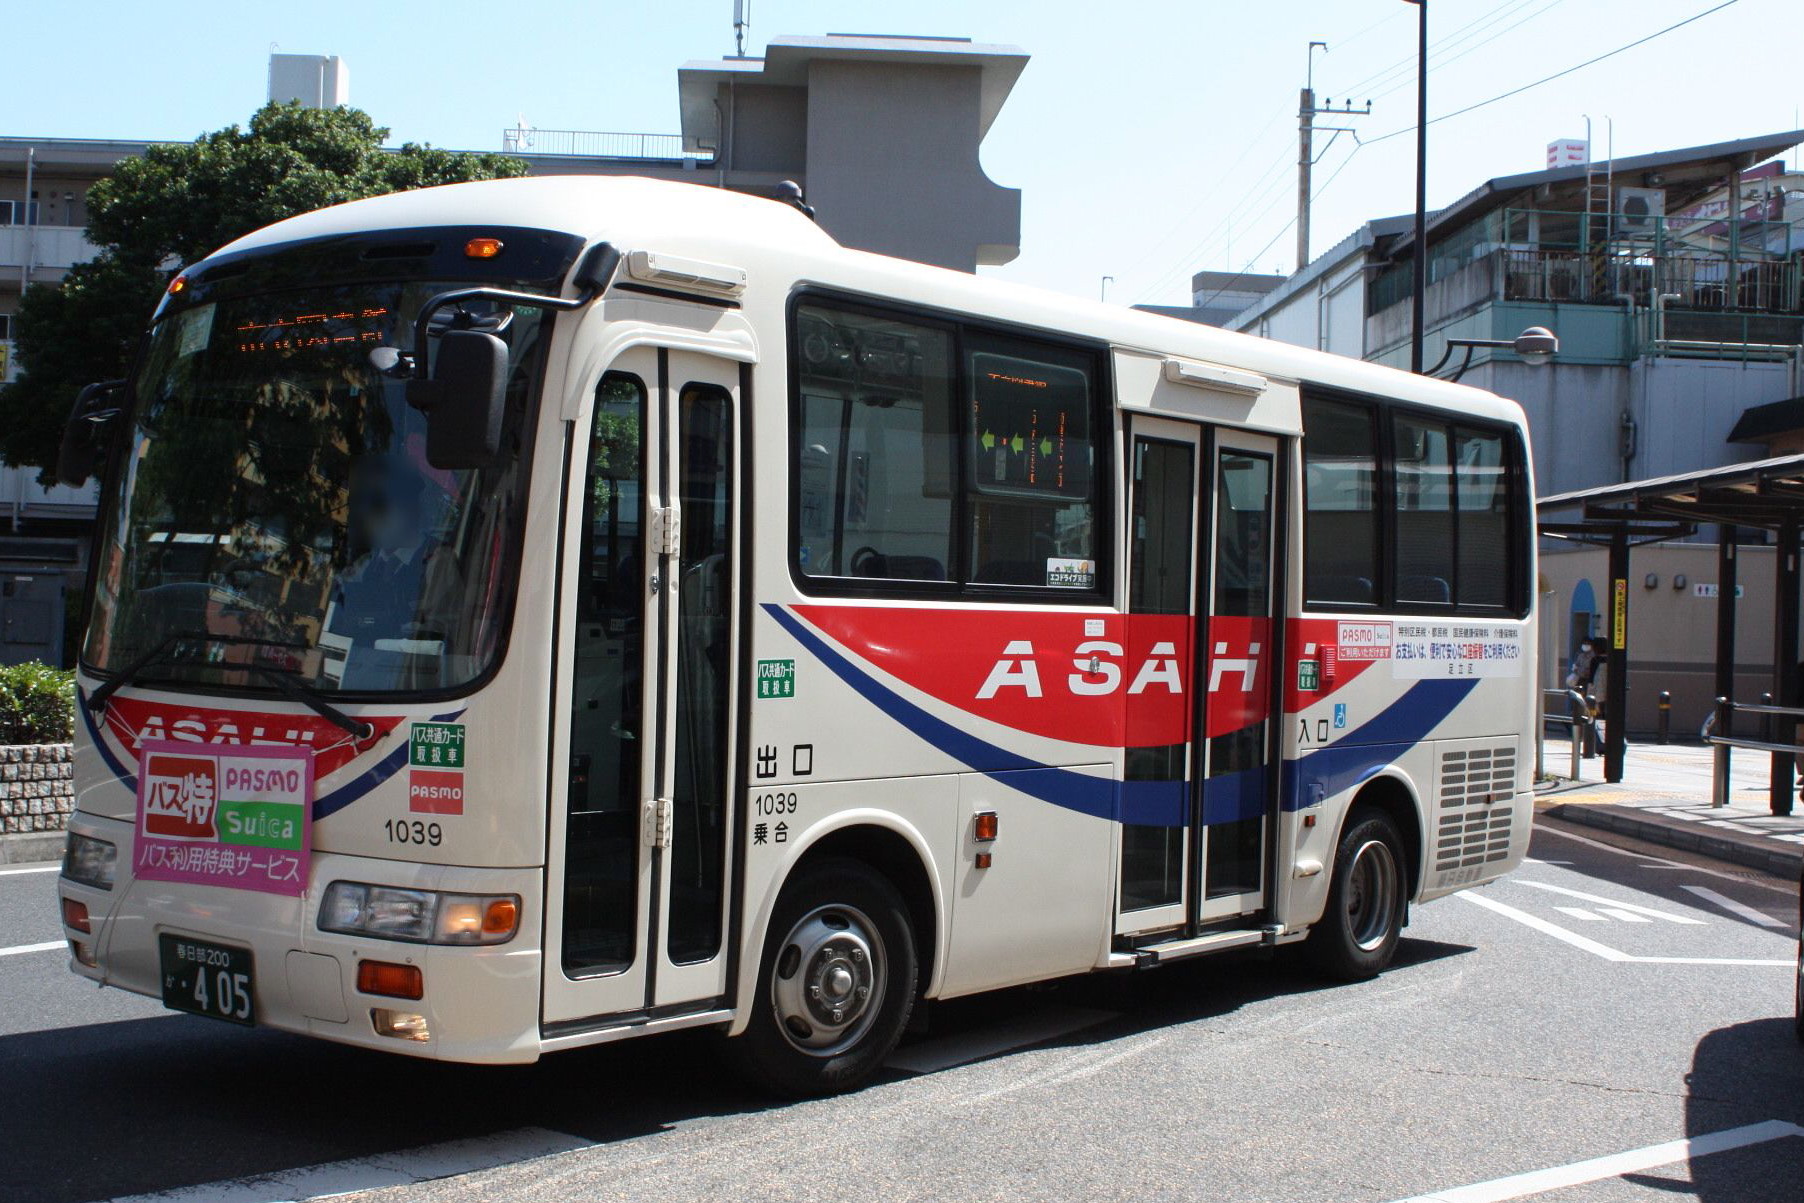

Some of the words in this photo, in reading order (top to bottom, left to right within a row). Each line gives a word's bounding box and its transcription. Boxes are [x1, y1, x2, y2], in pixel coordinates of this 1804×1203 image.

[1342, 629, 1373, 642] PASMO
[975, 640, 1317, 699] ASAH
[411, 726, 464, 745] バス共通カード
[1298, 719, 1329, 743] 入口
[416, 745, 457, 764] 取扱車
[756, 743, 813, 778] 出口
[225, 767, 299, 793] PASMO
[411, 785, 462, 800] PASMO
[147, 772, 214, 825] バス特
[755, 792, 798, 817] 1039
[225, 810, 294, 839] Suica
[384, 818, 443, 847] 1039
[753, 820, 789, 846] 乗合
[139, 842, 301, 883] バス利用特典サービス
